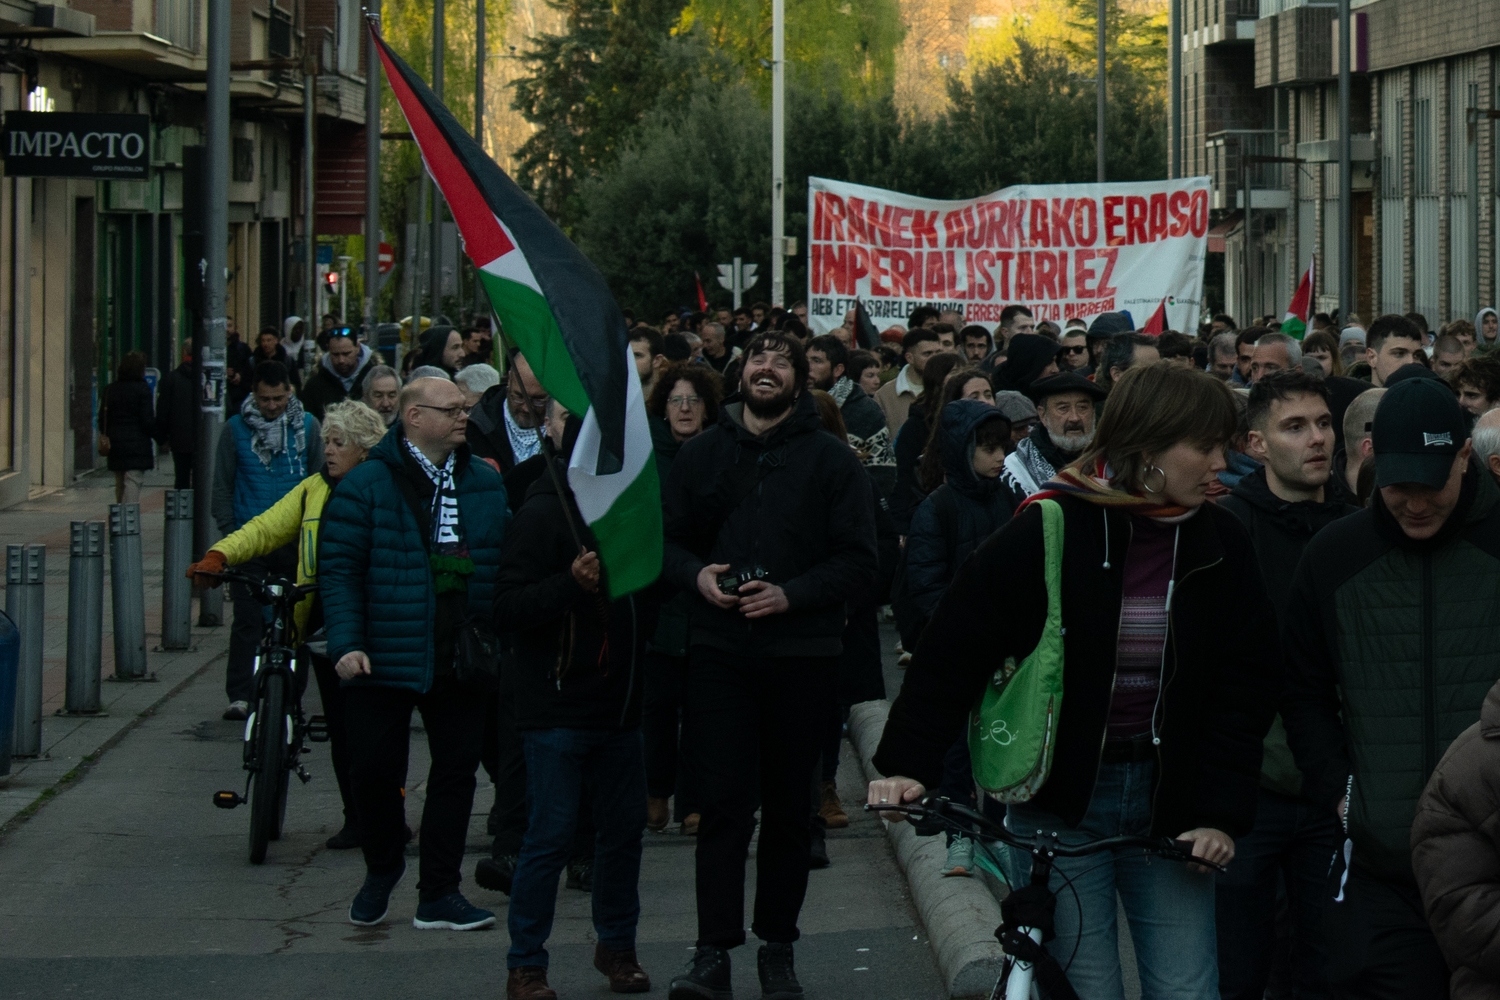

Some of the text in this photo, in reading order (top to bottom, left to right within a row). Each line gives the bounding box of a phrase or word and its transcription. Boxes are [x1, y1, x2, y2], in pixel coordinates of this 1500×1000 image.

[9, 130, 144, 159] IMPACTO
[813, 188, 1209, 250] IRANEN AURKAKO ERASO
[811, 243, 1119, 301] INPERIALISTARI EZ
[811, 298, 833, 316] AEB
[966, 302, 1061, 323] ERRESTZIA
